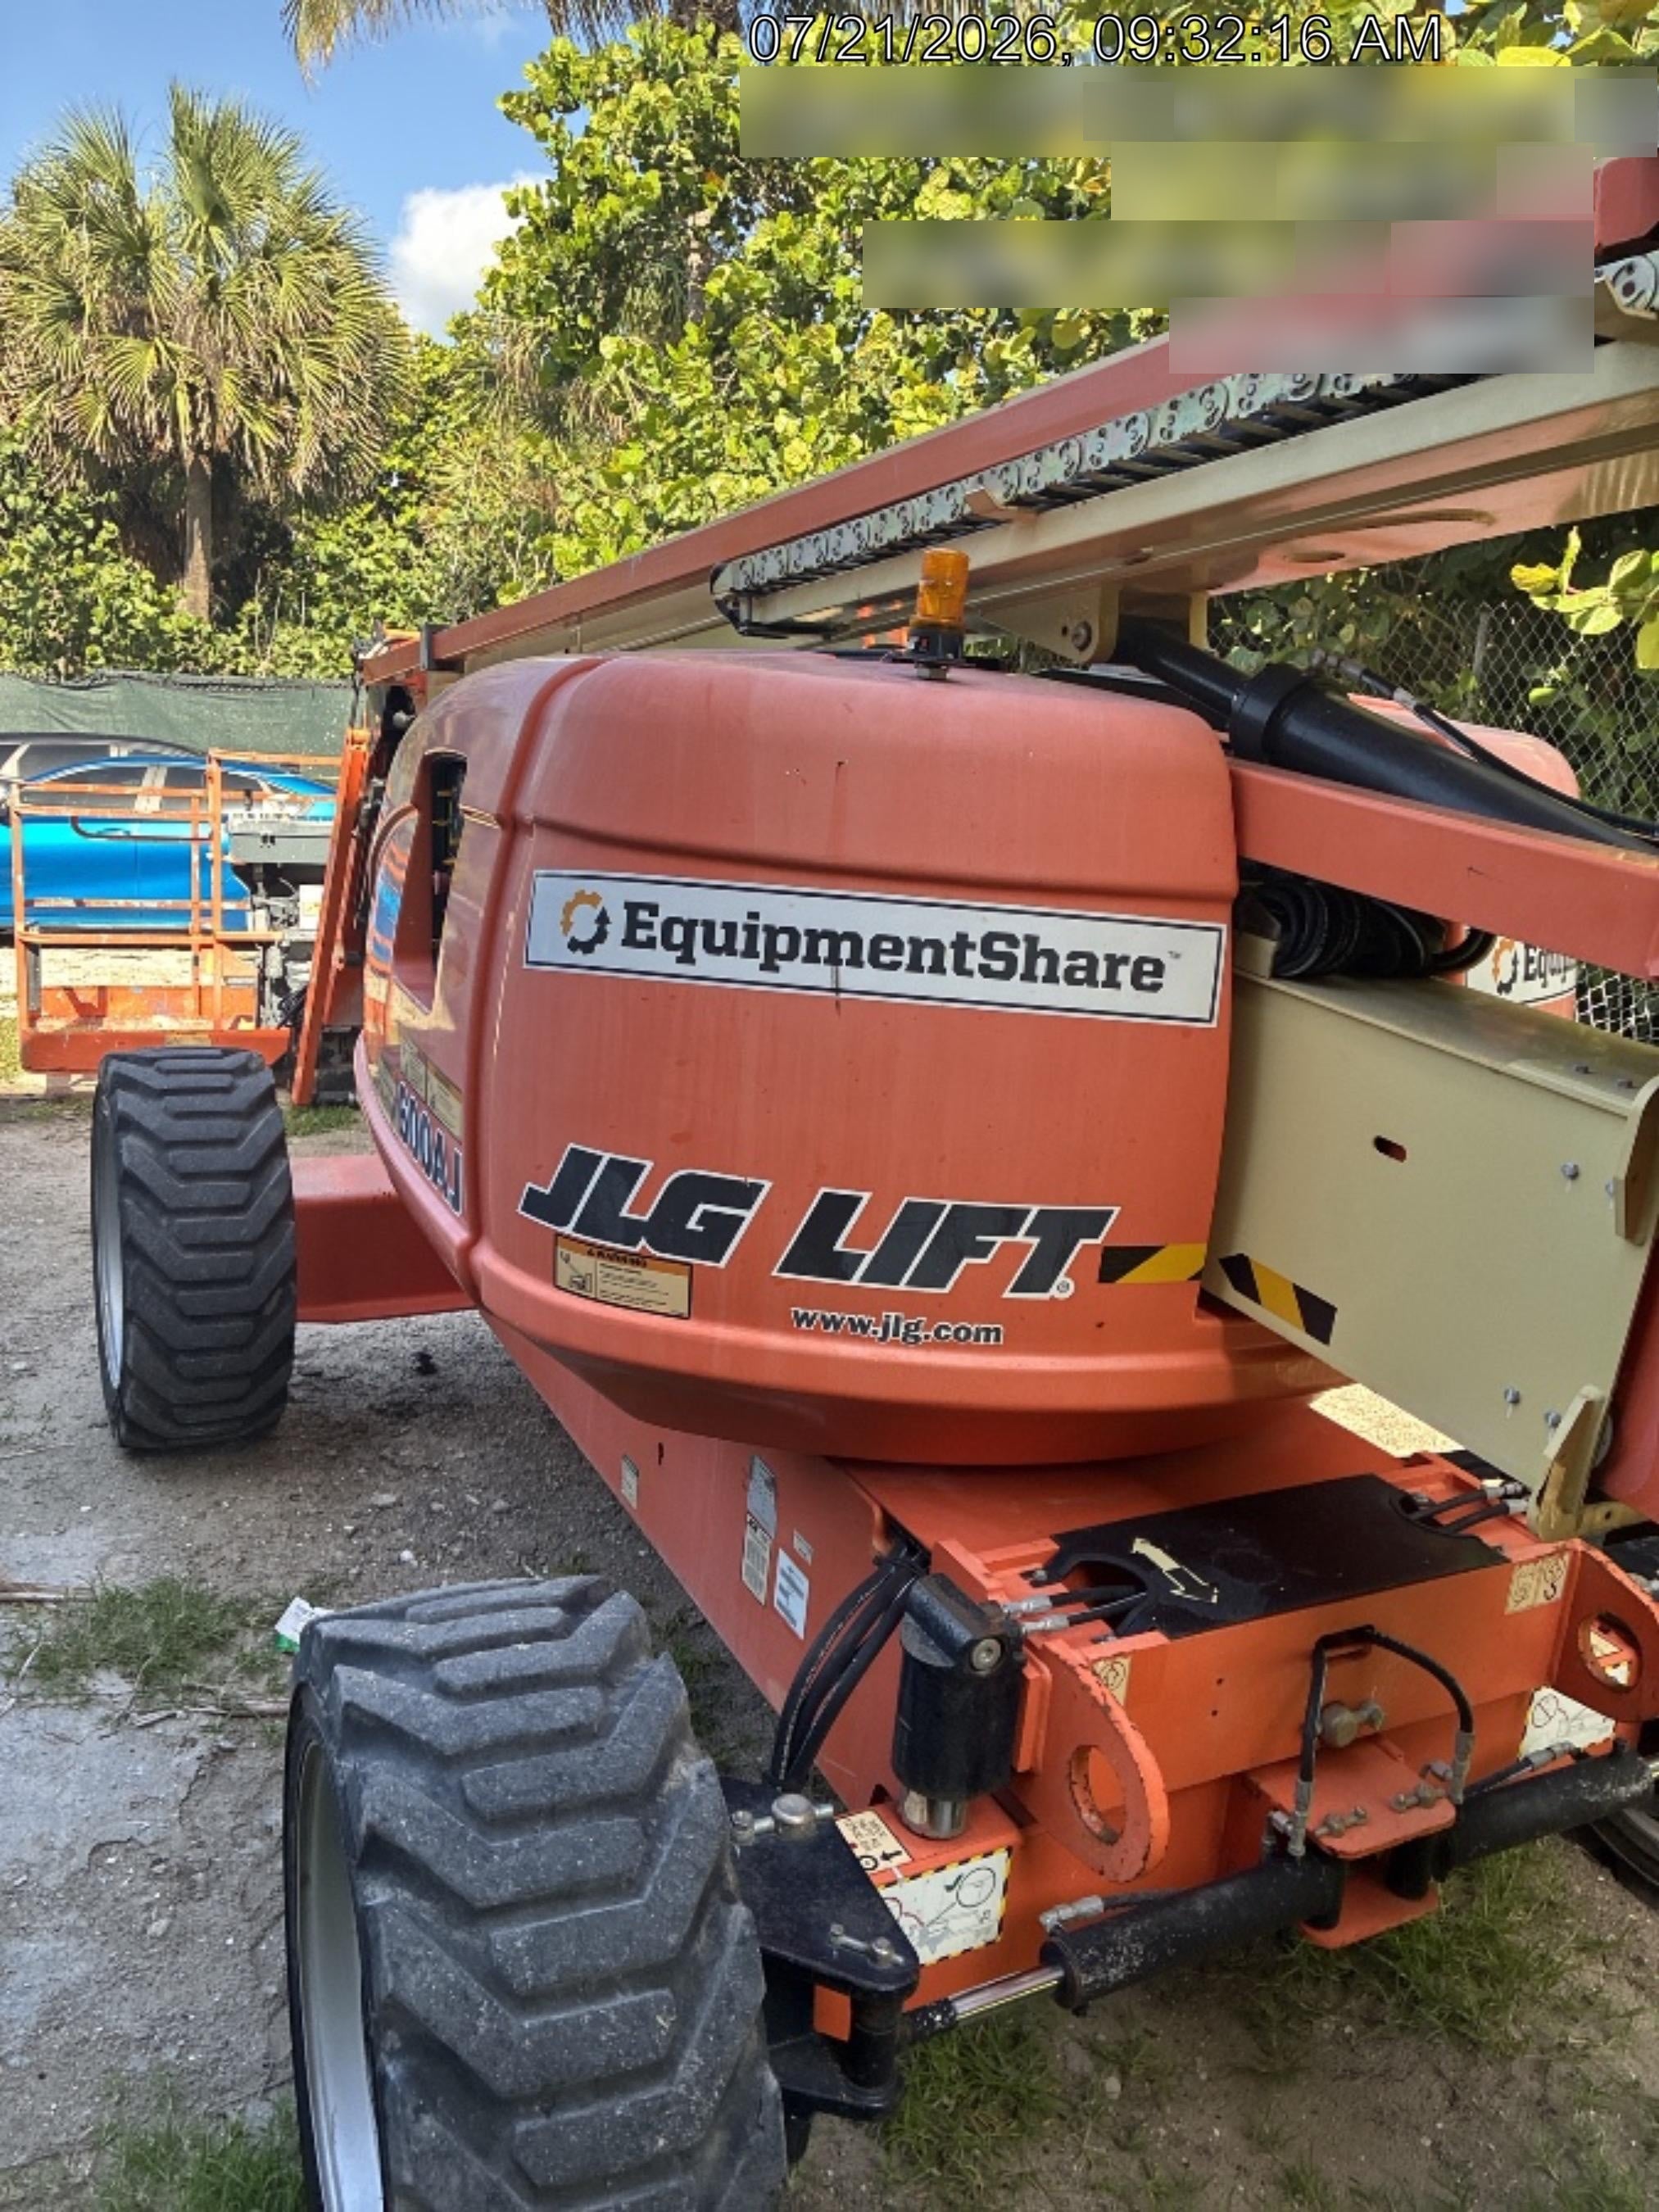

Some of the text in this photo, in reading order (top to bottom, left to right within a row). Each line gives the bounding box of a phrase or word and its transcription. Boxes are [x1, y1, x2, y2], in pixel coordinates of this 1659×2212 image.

[621, 900, 1167, 995] EquipmentShare
[518, 1144, 1121, 1299] JLG LIFT
[791, 1306, 1004, 1345] www.jlg.com
